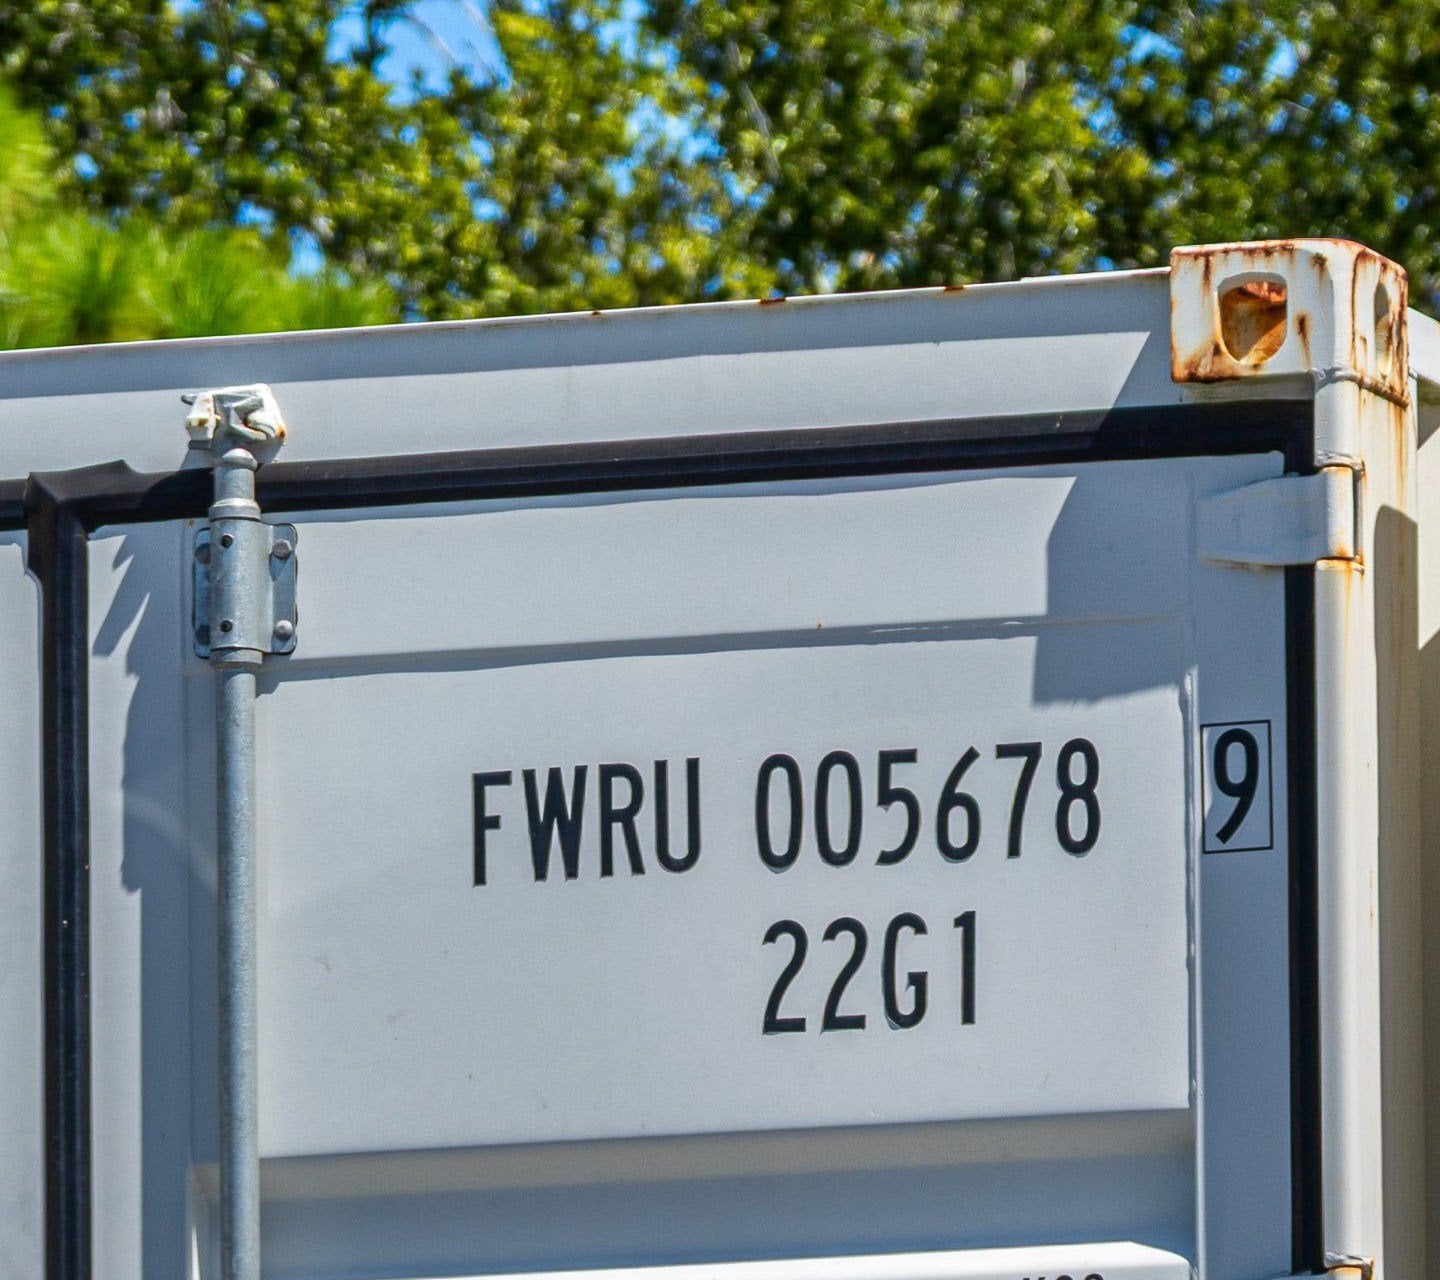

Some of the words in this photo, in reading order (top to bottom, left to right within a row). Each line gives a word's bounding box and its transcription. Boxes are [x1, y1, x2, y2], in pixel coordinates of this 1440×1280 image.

[472, 758, 701, 886] FWRU
[754, 737, 1101, 870] 005678
[1212, 728, 1261, 845] 9
[762, 910, 976, 1034] 22G1
